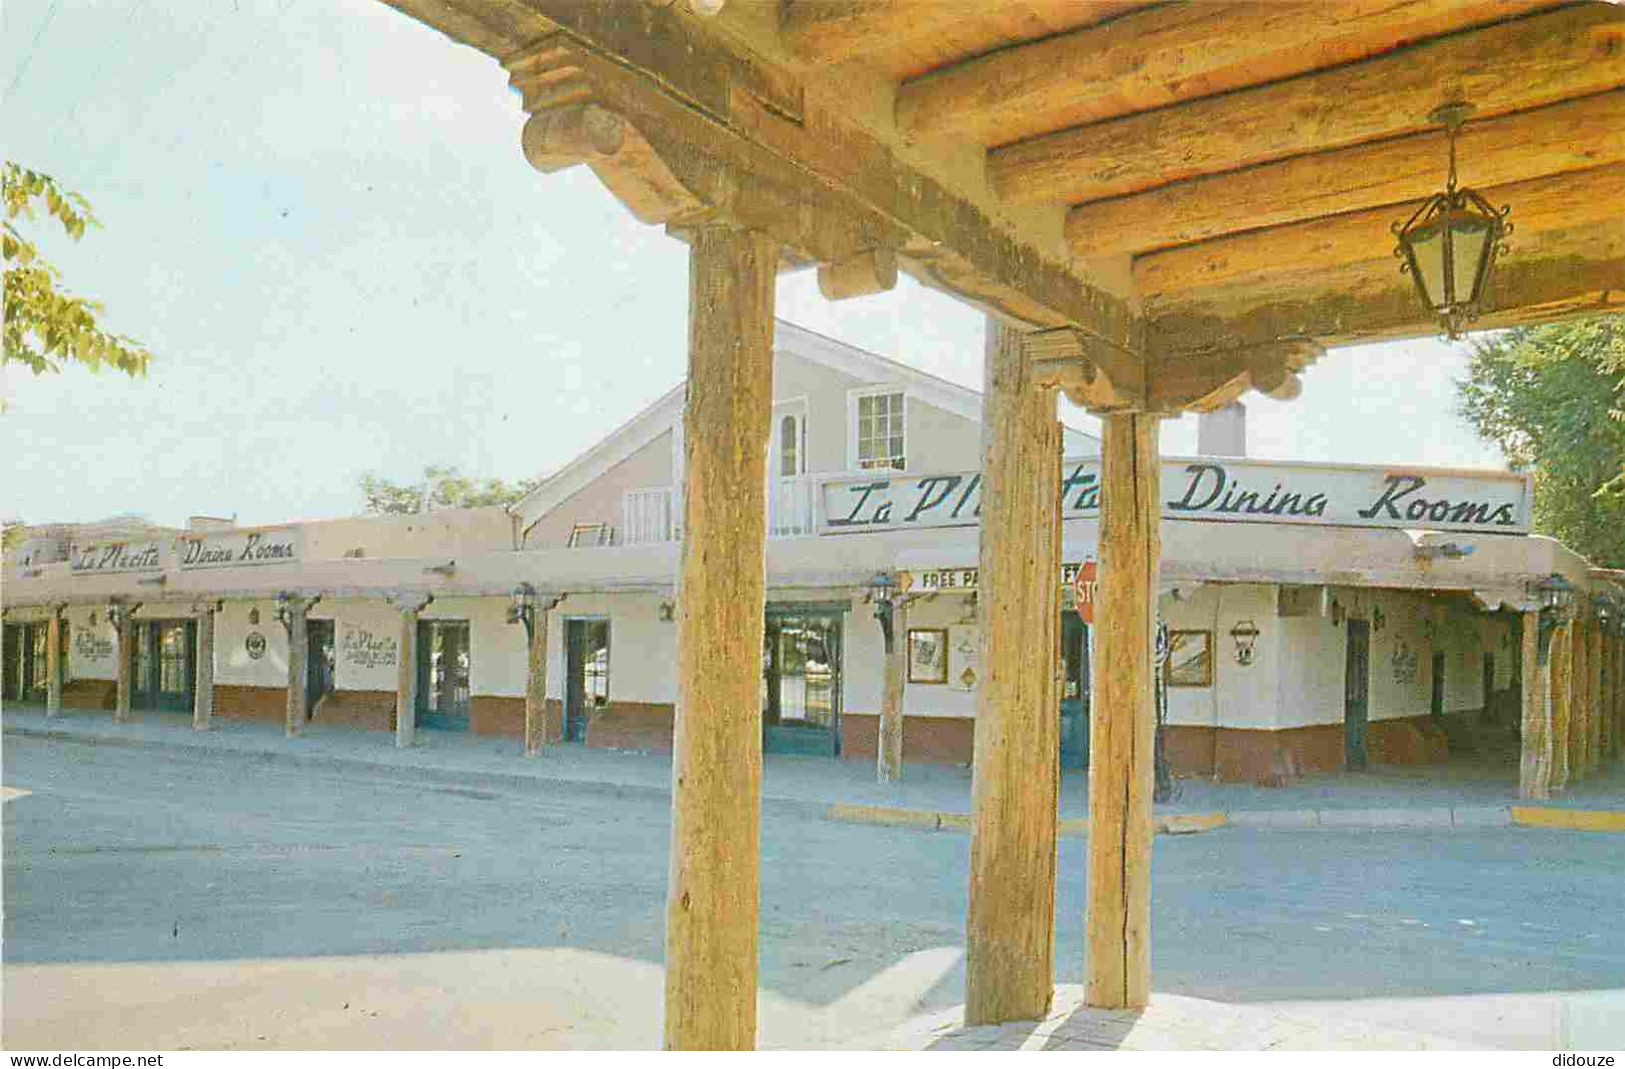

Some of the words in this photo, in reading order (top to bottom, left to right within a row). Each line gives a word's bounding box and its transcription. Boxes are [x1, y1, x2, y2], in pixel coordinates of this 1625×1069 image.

[827, 481, 893, 526] La
[1358, 475, 1516, 525] Rooms
[239, 533, 294, 560] Rooms
[922, 571, 955, 588] FREE
